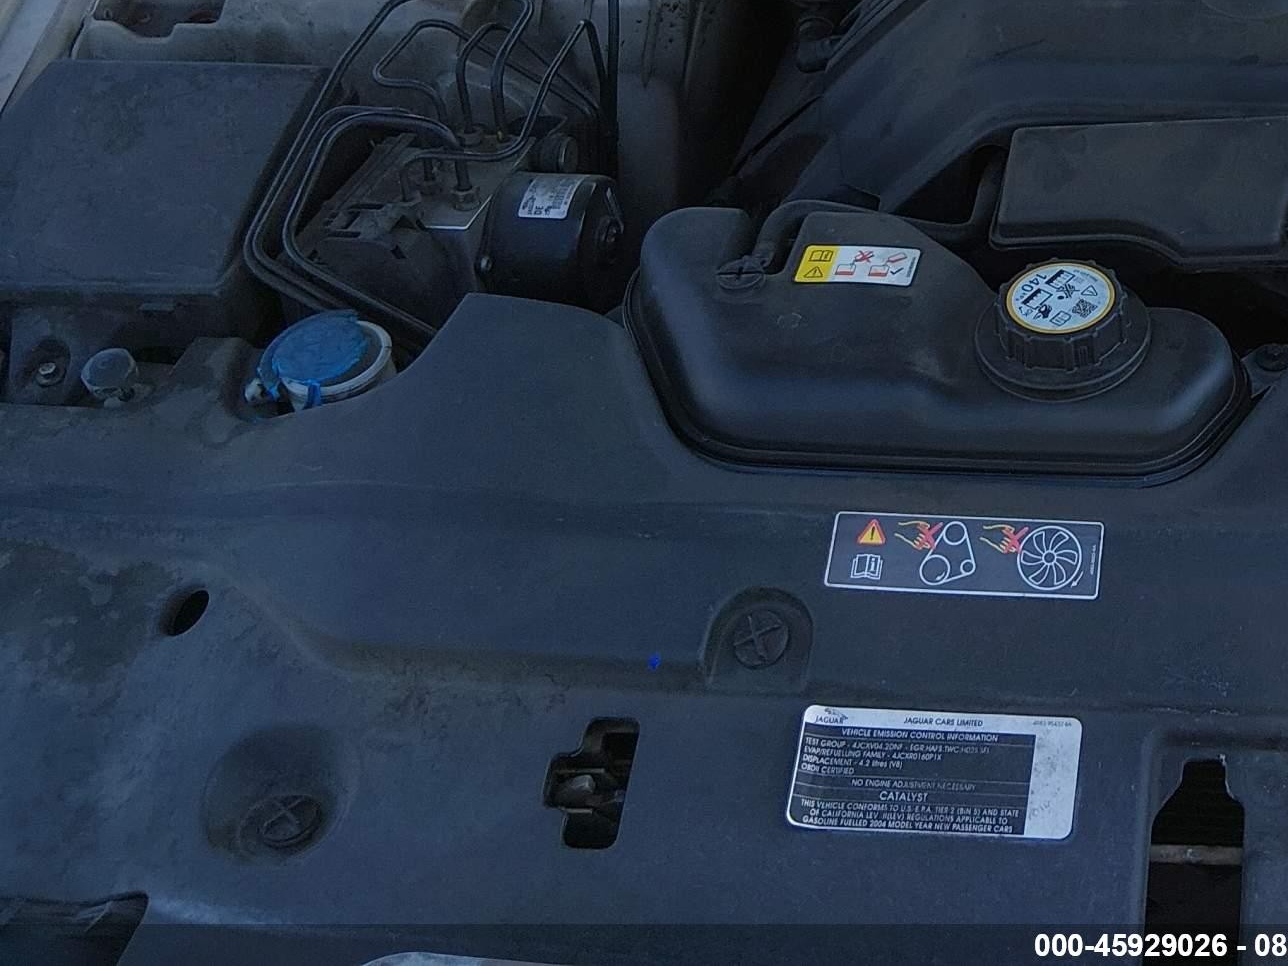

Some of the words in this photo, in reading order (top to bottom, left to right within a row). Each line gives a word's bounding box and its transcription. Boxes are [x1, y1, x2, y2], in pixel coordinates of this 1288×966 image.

[814, 715, 843, 725] JAGUAR
[903, 717, 933, 725] JAGUAR
[935, 718, 955, 726] CARS
[957, 719, 984, 727] LIMITED
[842, 727, 872, 736] VEHICLE
[873, 729, 908, 738] EMISSION
[910, 731, 944, 740] CONTROL
[947, 733, 999, 742] INFORMATION
[805, 737, 819, 745] TEST
[821, 738, 846, 747] GROUP
[862, 750, 886, 758] FAMILY
[802, 753, 853, 766] DISPLACEMENT
[889, 760, 903, 769] (V8)
[821, 765, 855, 775] CERTIFIED
[851, 778, 864, 787] NO
[866, 779, 892, 788] ENGINE
[879, 790, 929, 803] CATALYST
[801, 798, 816, 807] THIS
[818, 800, 845, 809] VEHICLE
[847, 802, 889, 812] CONFORMS
[890, 804, 899, 812] TO
[982, 808, 998, 817] AND
[1000, 809, 1019, 818] STATE
[809, 808, 820, 816] OF
[821, 810, 865, 820] CALIFORNIA
[906, 814, 954, 824] REGULATIONS
[956, 816, 996, 825] APPLICABLE
[998, 817, 1008, 825] TO
[802, 815, 838, 826] GASOLINE
[840, 818, 868, 827] FUELLED
[869, 819, 886, 828] 2004
[888, 820, 914, 829] MODEL
[914, 821, 933, 830] YEAR
[934, 823, 949, 831] NEW
[951, 823, 993, 833] PASSENGER
[994, 825, 1014, 834] CARS
